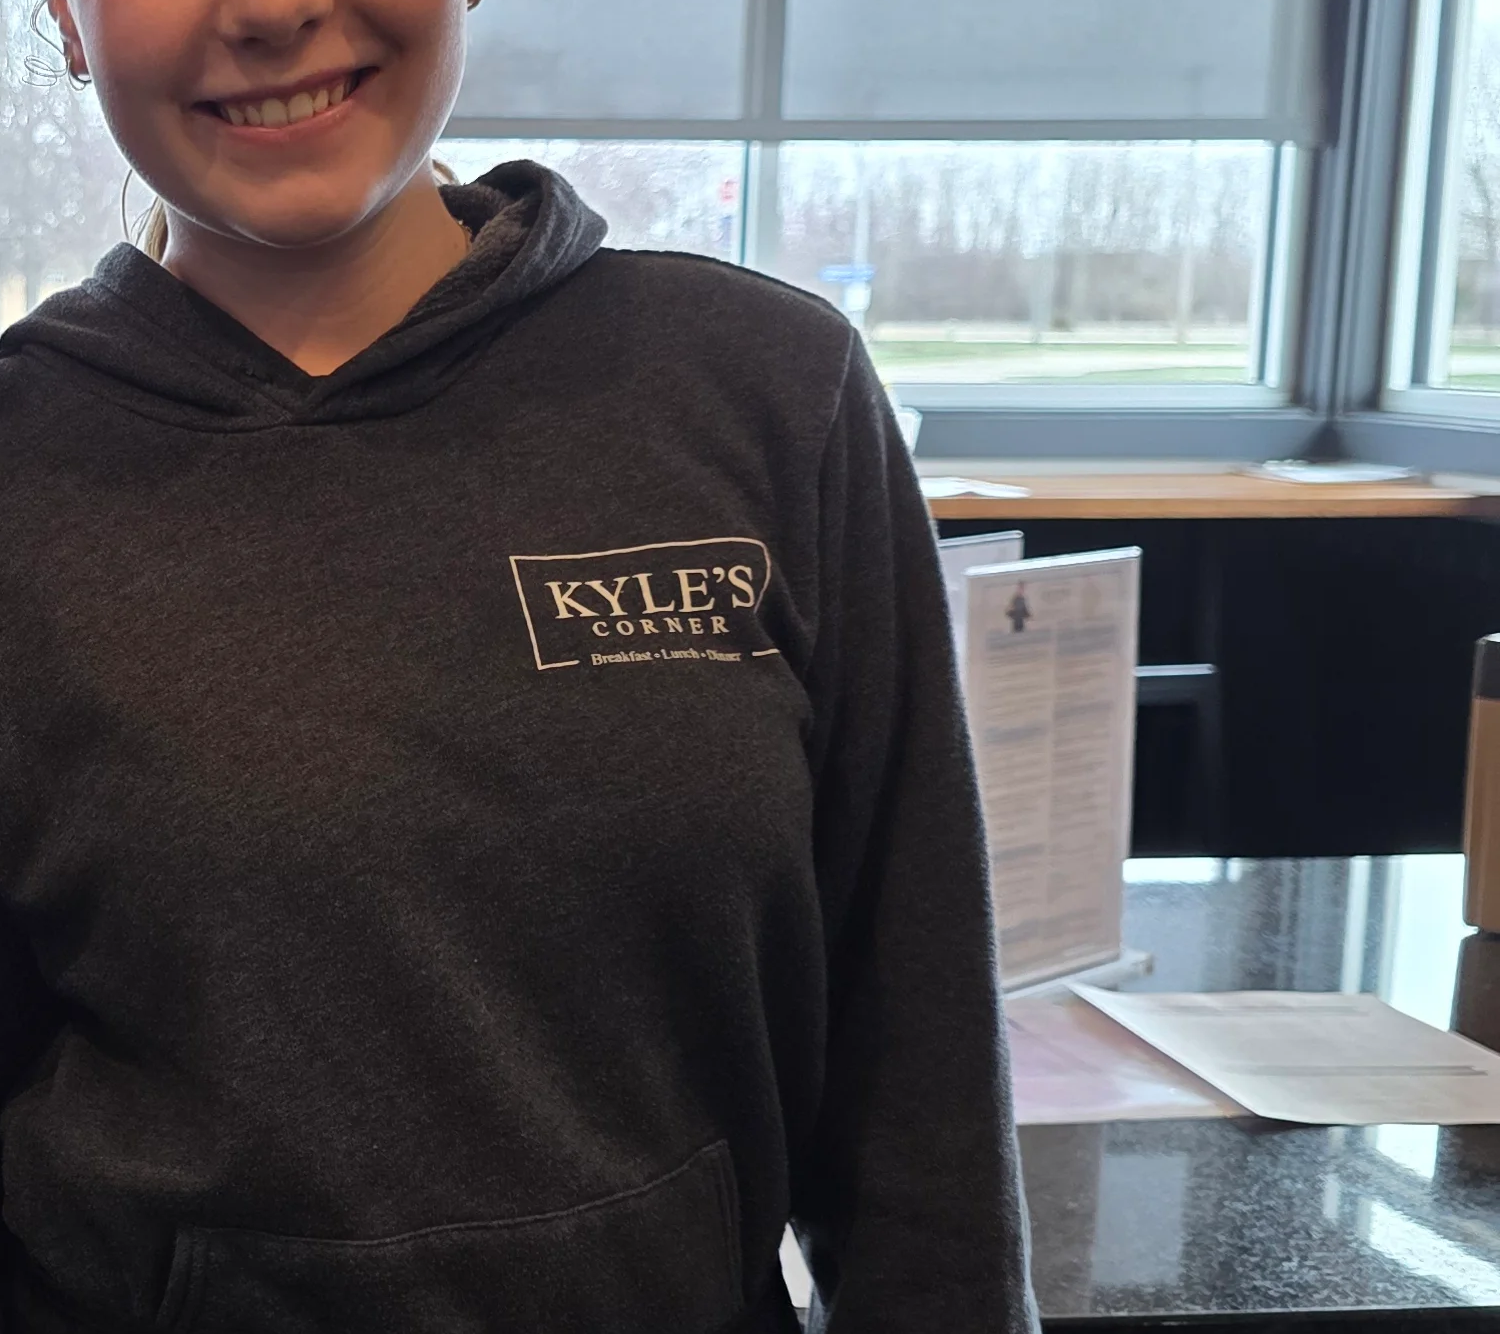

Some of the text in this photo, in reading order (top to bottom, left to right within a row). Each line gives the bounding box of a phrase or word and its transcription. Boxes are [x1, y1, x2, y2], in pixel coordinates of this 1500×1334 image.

[544, 565, 755, 619] KYLE'S
[591, 616, 730, 637] CORNER
[590, 648, 742, 666] Breakfast Lunch Dinner
